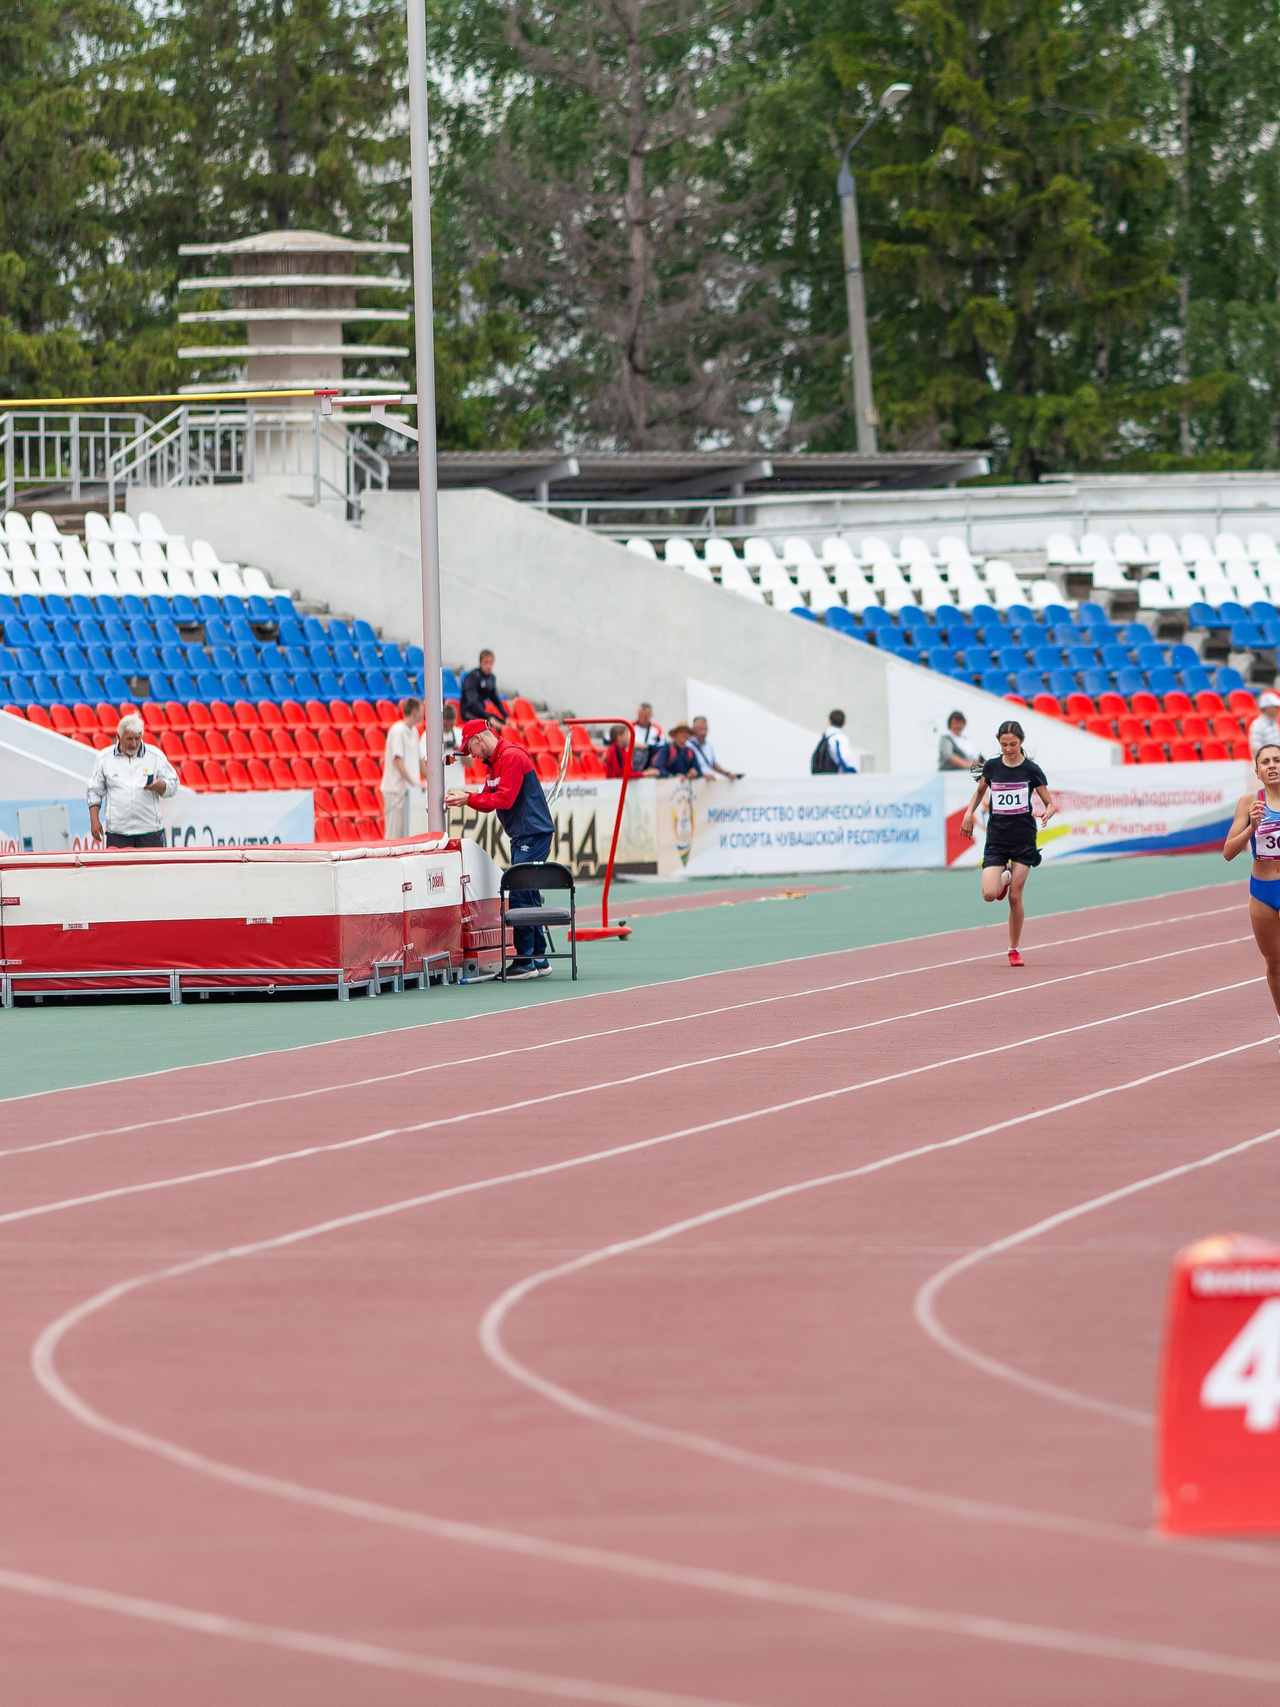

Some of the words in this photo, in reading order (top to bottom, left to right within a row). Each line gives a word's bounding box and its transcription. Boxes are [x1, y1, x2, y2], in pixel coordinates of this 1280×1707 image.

[998, 794, 1022, 805] 201
[708, 807, 794, 823] МИНИСТЕРСТВО
[797, 801, 871, 821] ФИЗИЧЕСКОЙ
[874, 802, 931, 818] КУЛЬТУРЫ
[720, 834, 728, 848] И
[730, 832, 773, 849] СПОРТА
[776, 827, 844, 847] ЧУВАШСКОЙ
[847, 828, 920, 846] РЕСПУБЛИКИ
